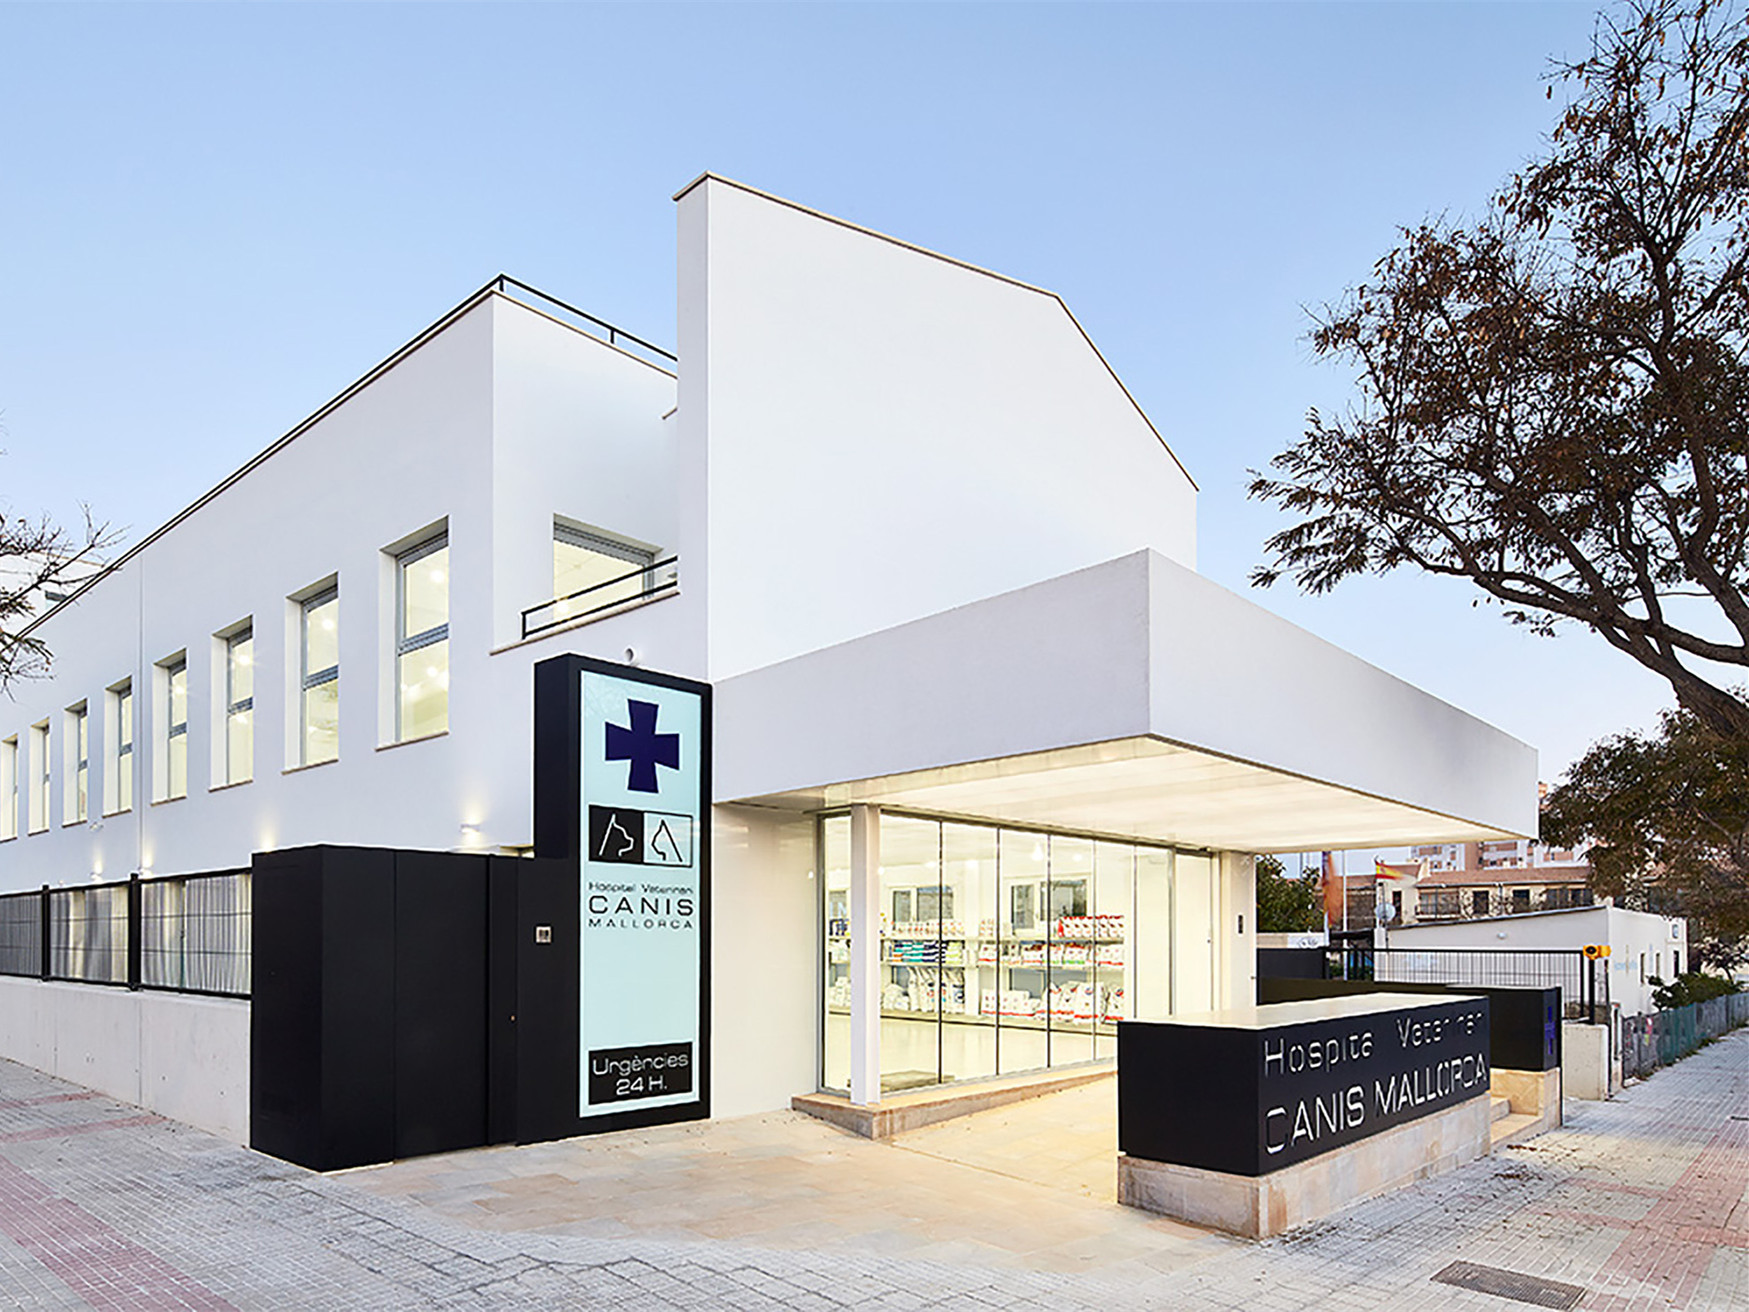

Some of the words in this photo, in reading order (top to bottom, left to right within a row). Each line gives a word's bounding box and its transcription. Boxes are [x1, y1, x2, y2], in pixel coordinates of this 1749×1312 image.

[588, 895, 694, 916] CANIS
[588, 918, 693, 930] MALLORCA
[592, 1052, 690, 1077] Urgències
[1264, 1031, 1374, 1077] Hospita
[616, 1076, 645, 1096] 24
[648, 1075, 668, 1092] H.
[1266, 1085, 1365, 1155] CANIS
[1375, 1052, 1488, 1117] MALLORCA
